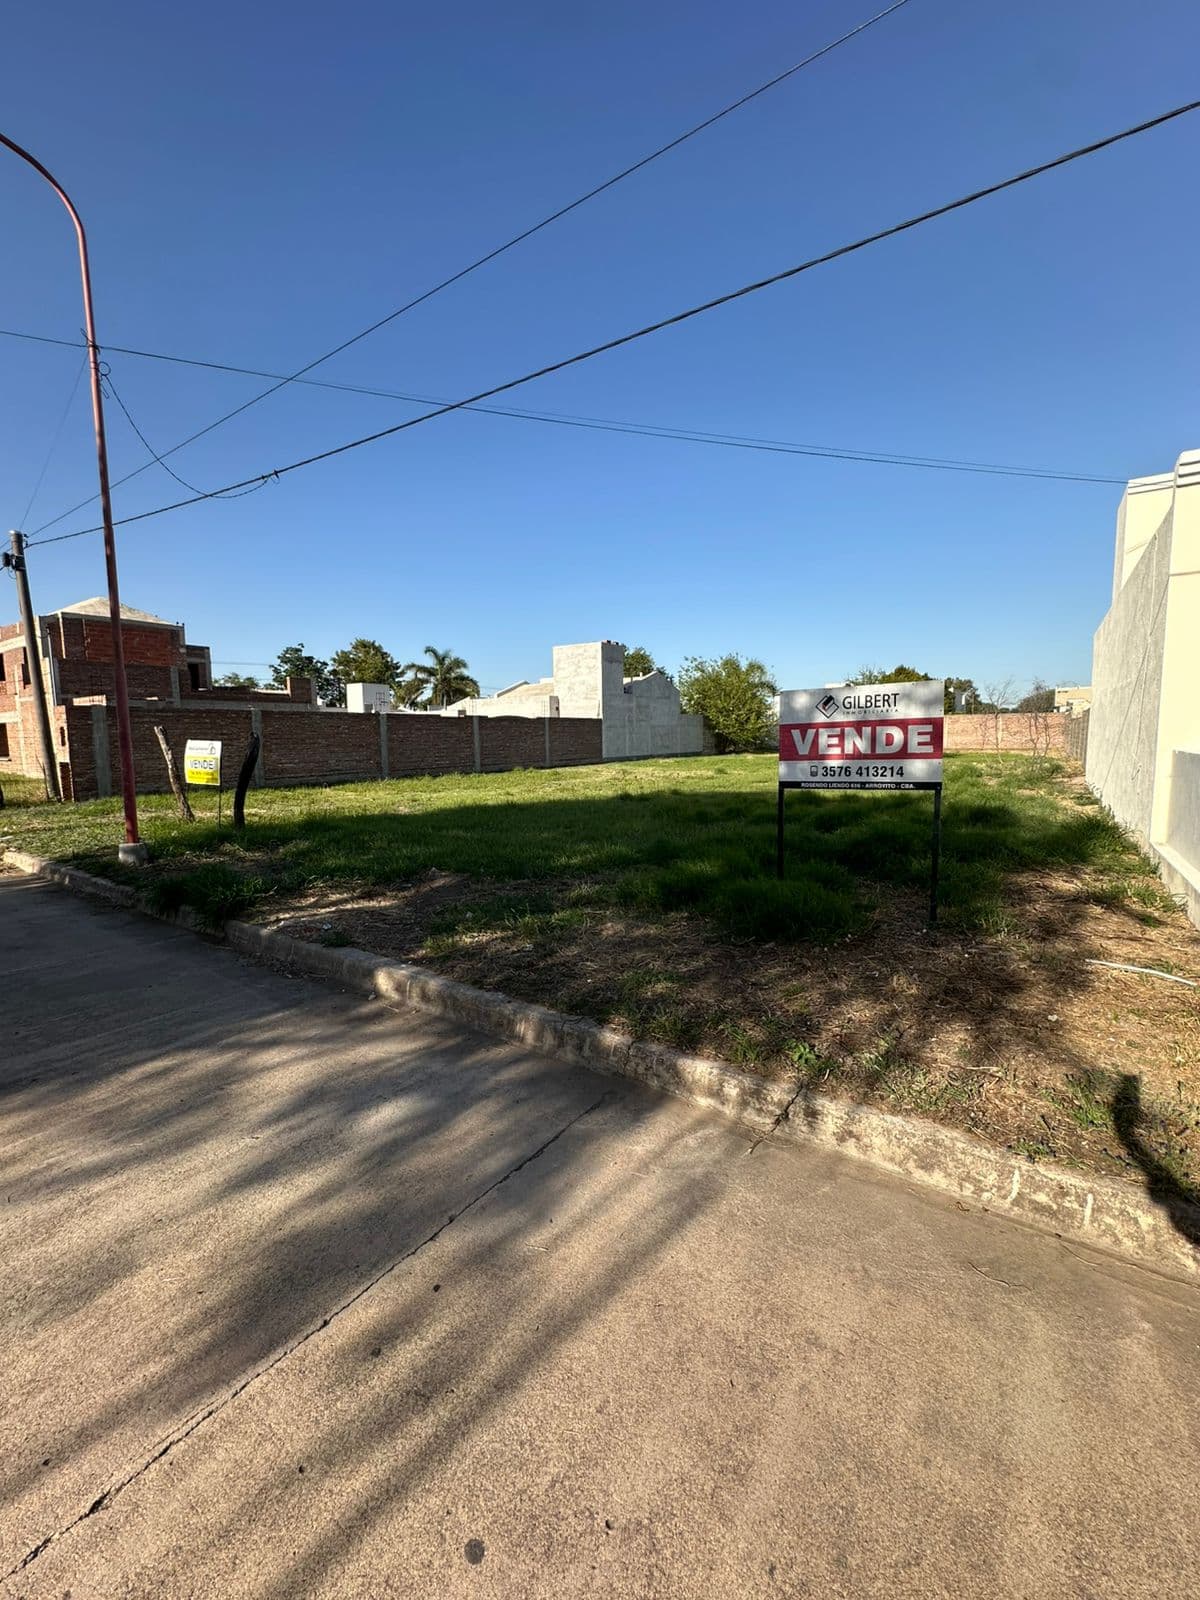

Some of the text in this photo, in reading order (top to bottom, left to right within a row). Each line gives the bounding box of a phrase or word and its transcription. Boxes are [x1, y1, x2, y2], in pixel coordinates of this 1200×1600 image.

[842, 693, 900, 709] GILBERT
[790, 724, 934, 755] VENDE
[189, 759, 215, 770] VENDE
[822, 766, 904, 777] 3576 413214
